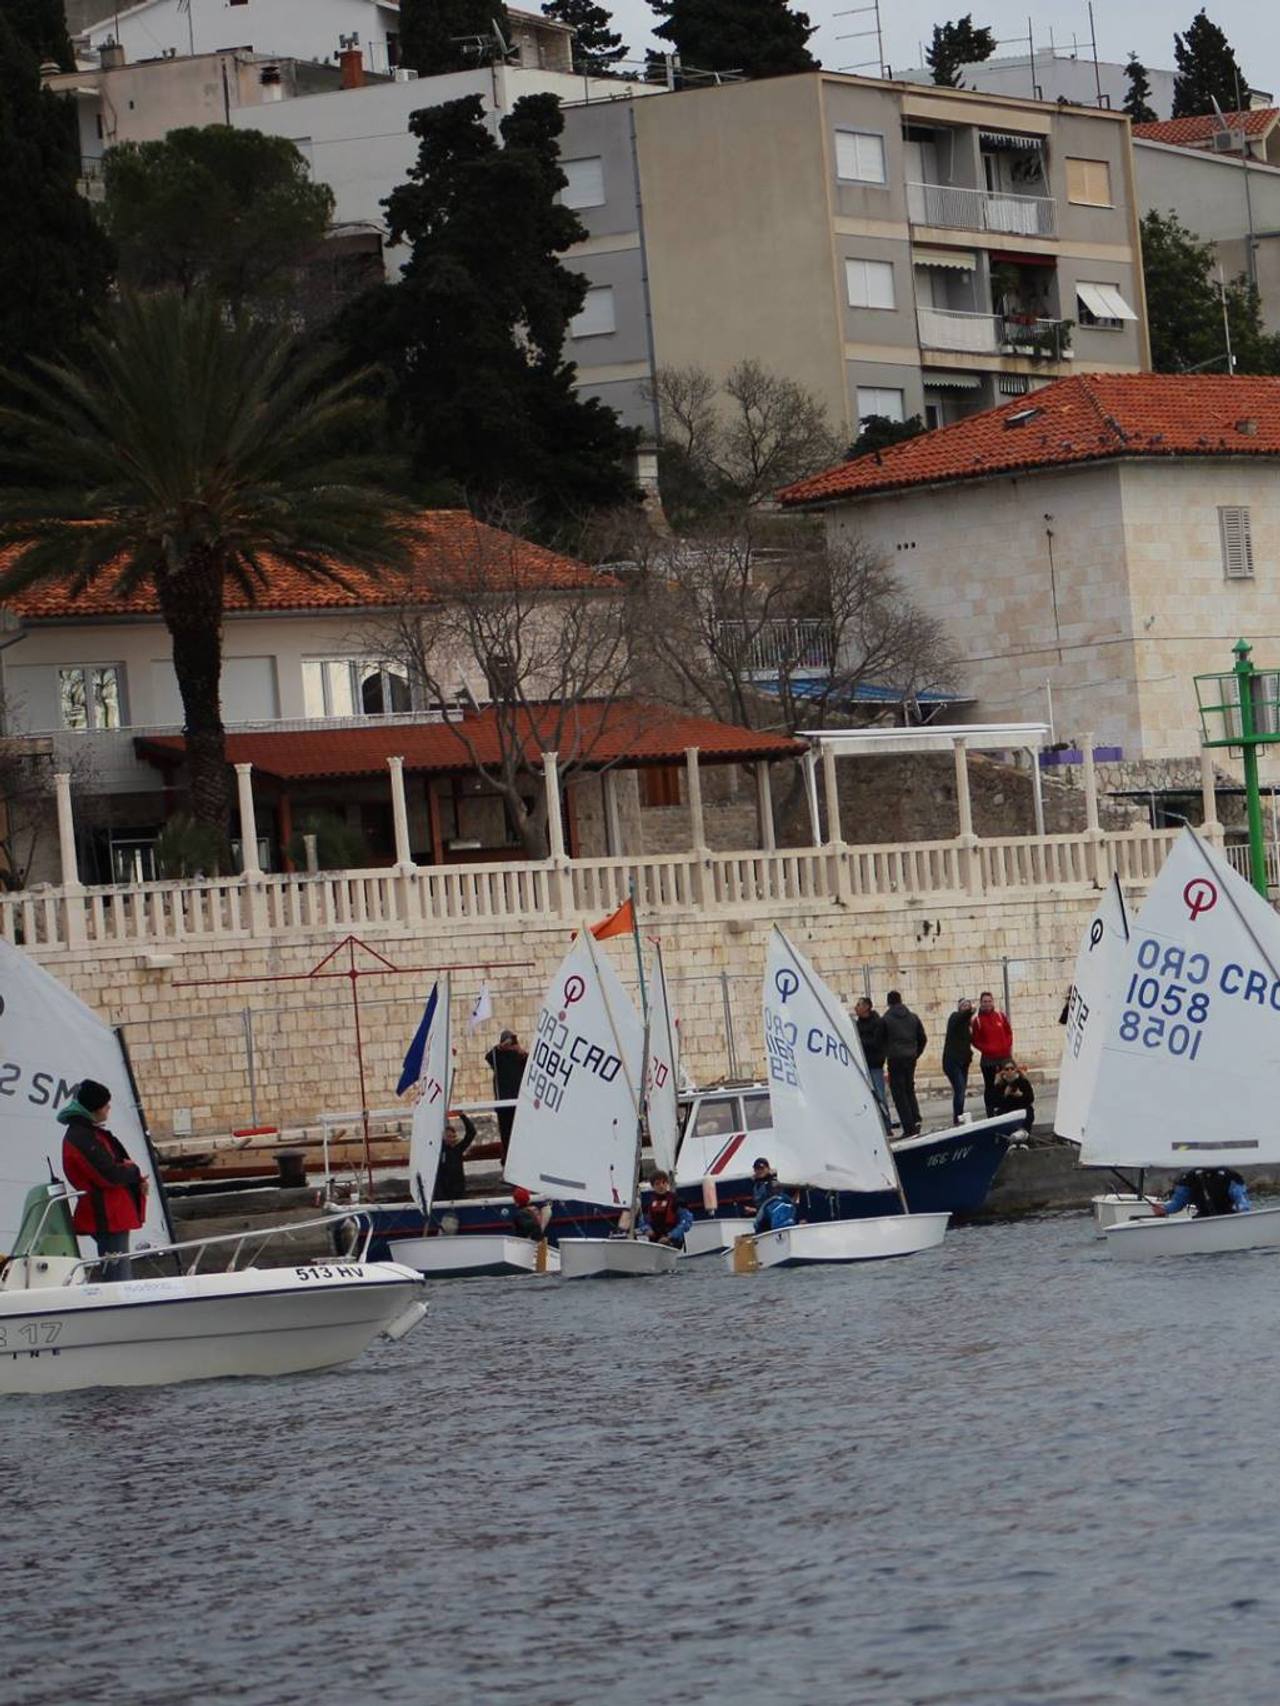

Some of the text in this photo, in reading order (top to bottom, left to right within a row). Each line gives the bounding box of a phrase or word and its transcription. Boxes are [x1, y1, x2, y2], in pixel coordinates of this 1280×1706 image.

[1126, 973, 1210, 1024] 1058
[532, 1038, 574, 1088] 1084
[570, 1035, 623, 1083] CRO
[807, 1028, 849, 1067] CRO
[28, 1072, 81, 1110] SM
[295, 1266, 365, 1281] 513 HV
[18, 1321, 63, 1345] 17
